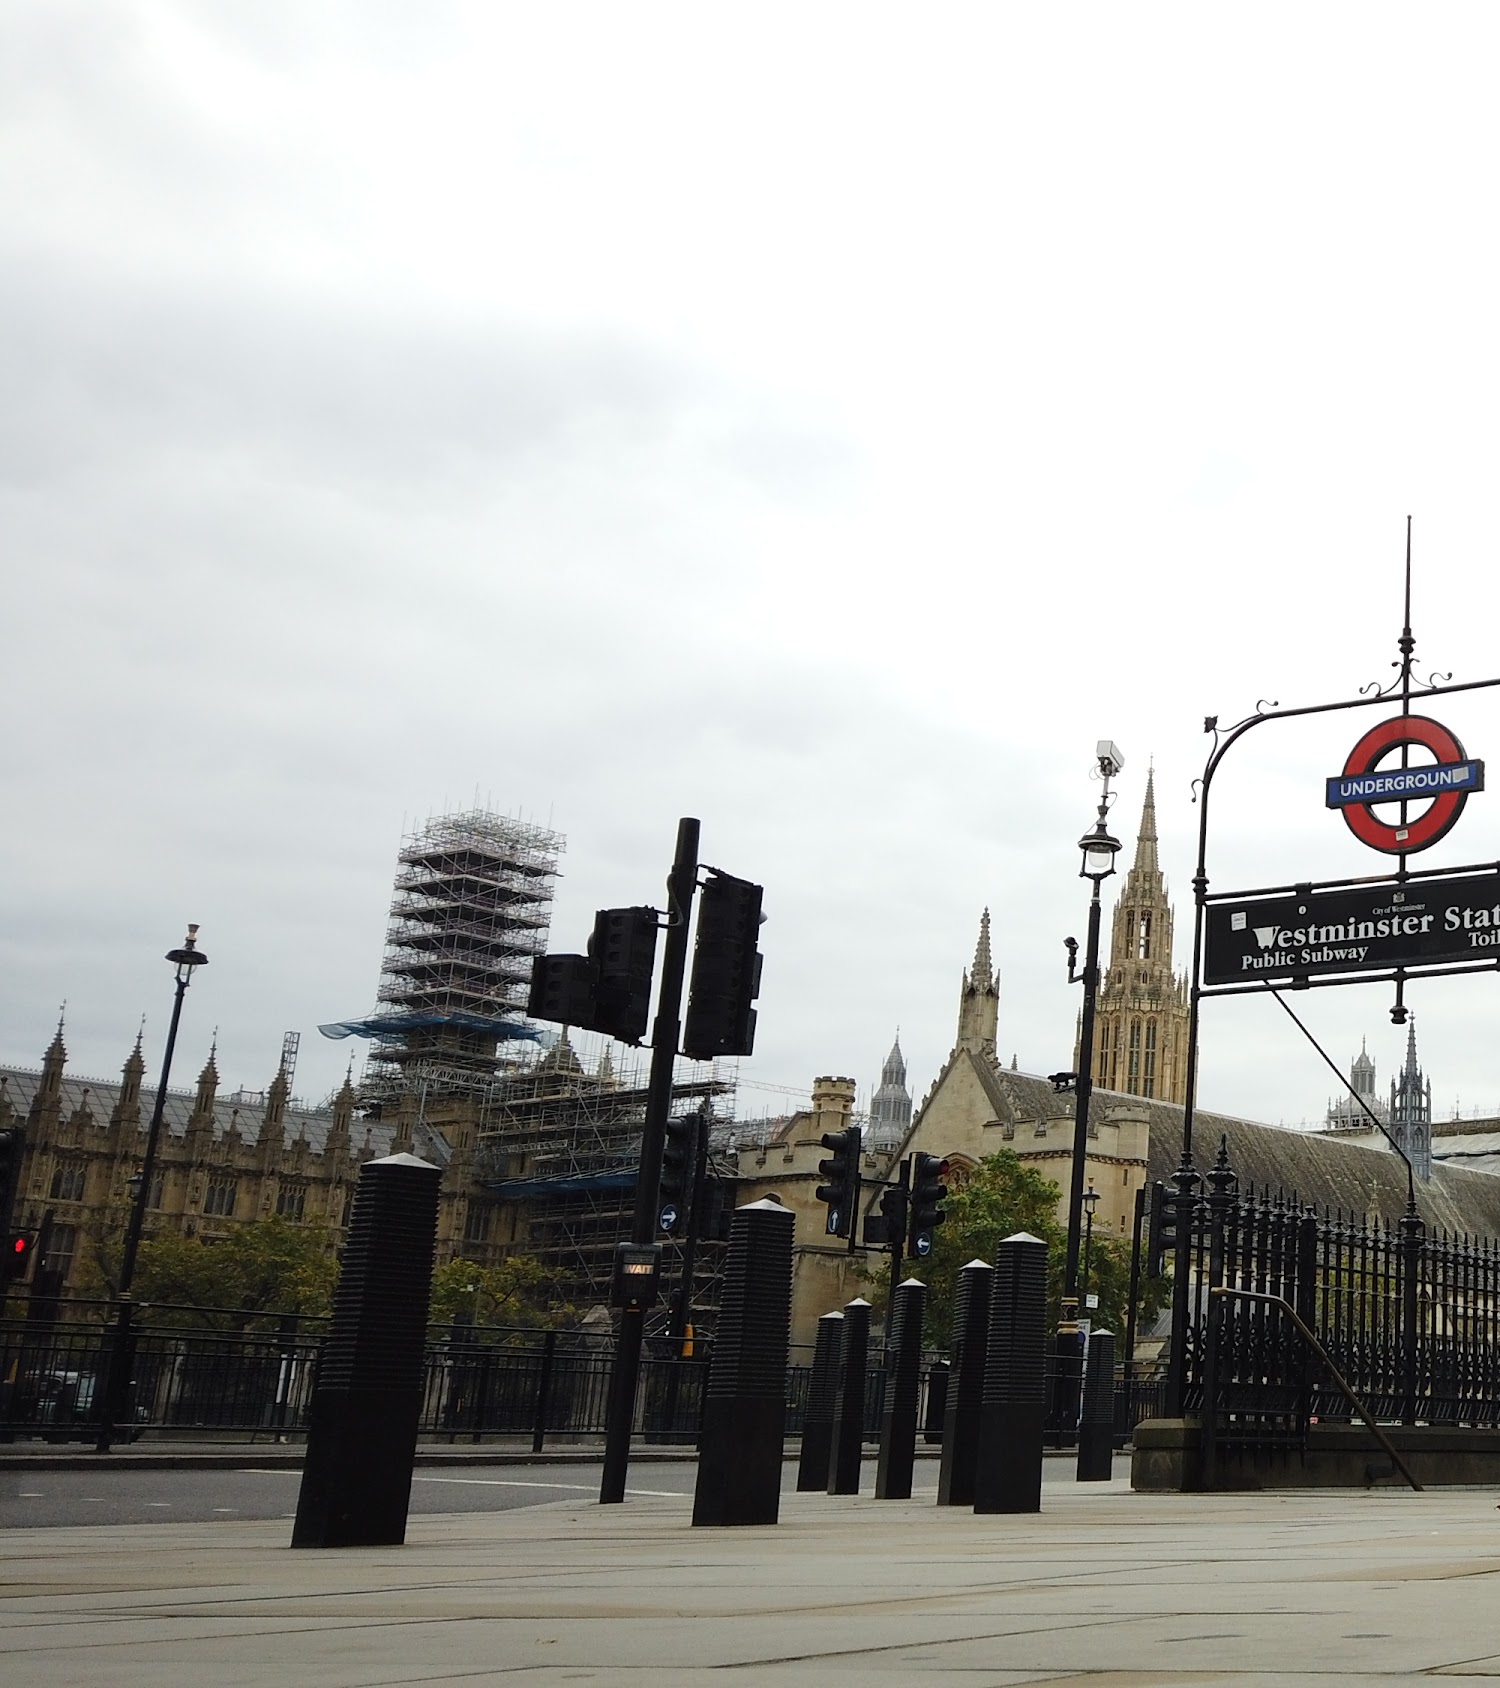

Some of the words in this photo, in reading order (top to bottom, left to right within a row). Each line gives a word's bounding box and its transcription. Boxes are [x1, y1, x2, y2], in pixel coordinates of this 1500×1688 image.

[1372, 907, 1384, 916] City
[1384, 905, 1391, 914] of
[1252, 915, 1435, 950] Westminster
[1241, 951, 1296, 970] Public
[1301, 946, 1369, 964] Subway
[625, 1264, 652, 1274] WAIT
